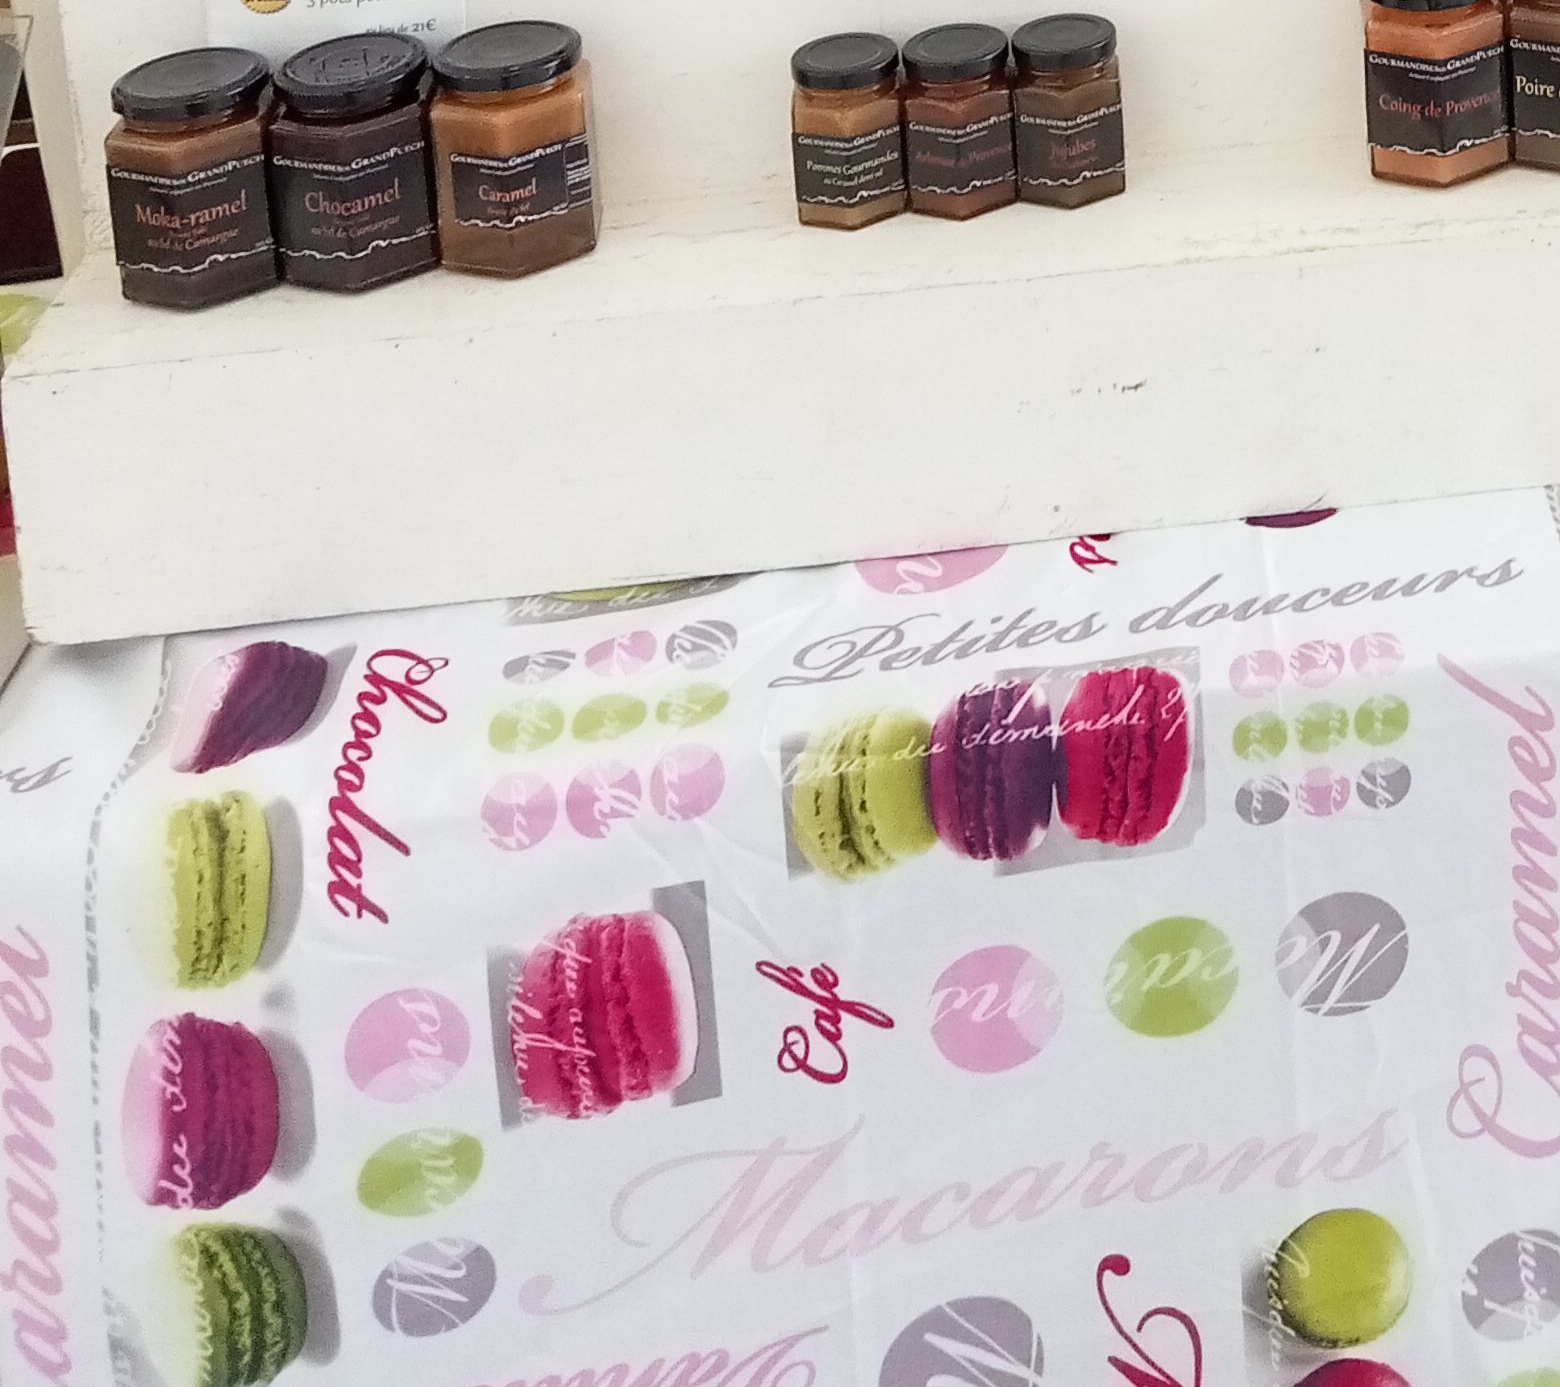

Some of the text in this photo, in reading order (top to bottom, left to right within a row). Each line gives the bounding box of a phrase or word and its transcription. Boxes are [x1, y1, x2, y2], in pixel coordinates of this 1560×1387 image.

[411, 18, 437, 32] 21€
[1515, 75, 1555, 98] Poire
[1379, 93, 1442, 120] Coing de
[134, 189, 249, 229] Moka-ramel
[305, 178, 401, 217] Chocamel
[478, 177, 538, 203] Caramel
[768, 557, 1528, 689] Petites douceurs
[325, 648, 449, 924] Chocolat
[0, 920, 72, 1387] aramel
[518, 1109, 1410, 1316] Macarons
